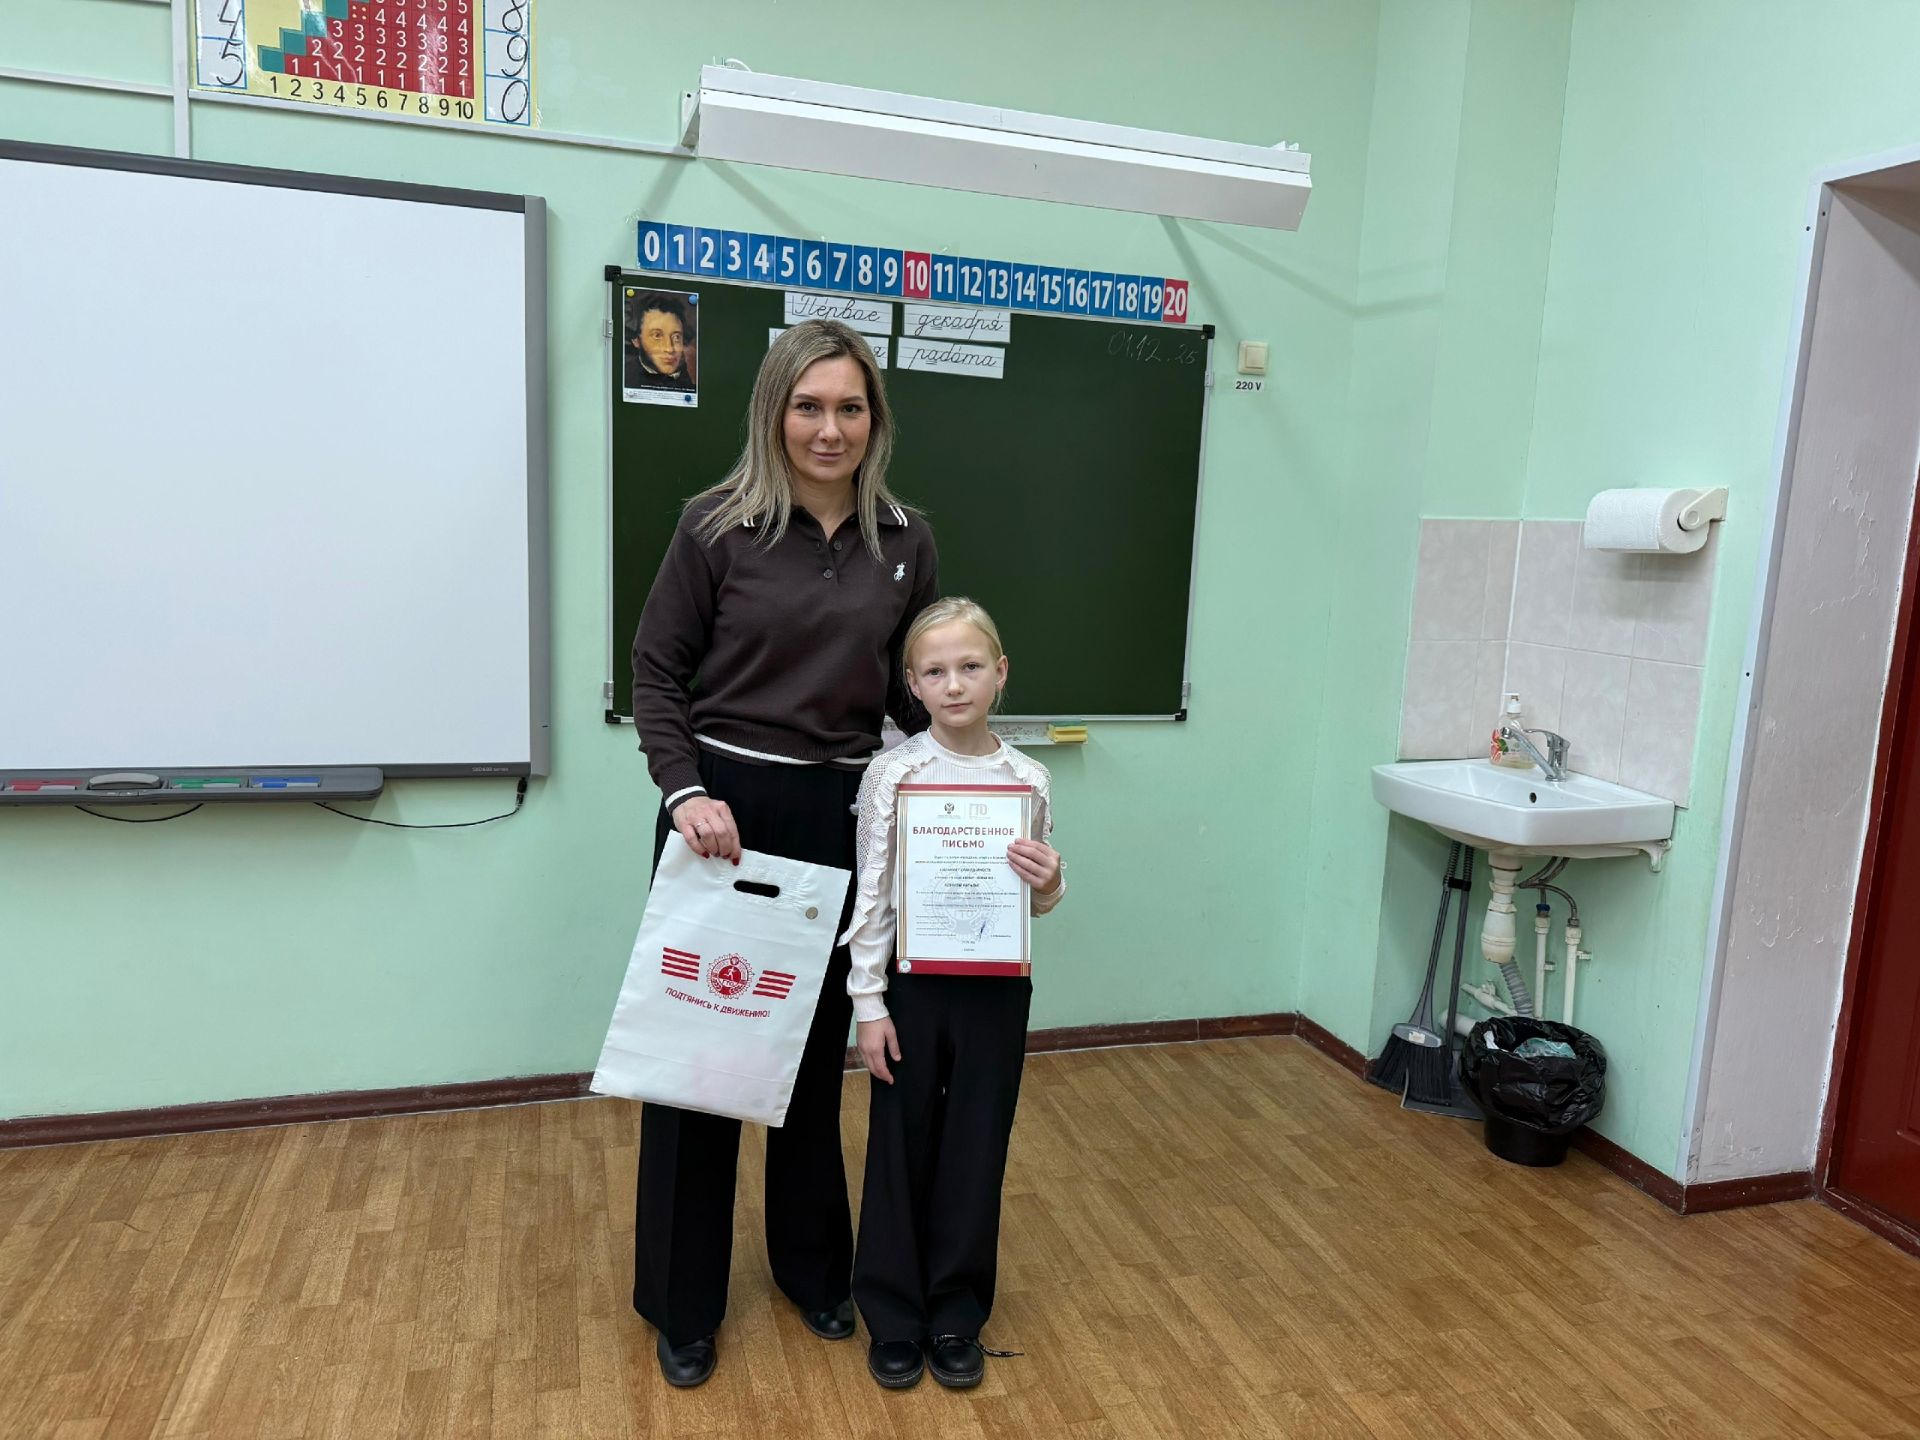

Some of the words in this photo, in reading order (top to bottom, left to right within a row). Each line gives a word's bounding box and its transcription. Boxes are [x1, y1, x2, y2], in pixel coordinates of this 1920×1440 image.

[219, 0, 242, 39] 4
[375, 8, 386, 25] 4
[396, 11, 407, 28] 4
[417, 14, 427, 30] 4
[437, 16, 448, 32] 4
[457, 19, 468, 35] 4
[458, 0, 467, 14] 5
[502, 0, 527, 32] 8
[333, 20, 343, 37] 3
[354, 24, 365, 41] 3
[376, 27, 386, 44] 3
[397, 31, 406, 48] 3
[418, 33, 427, 50] 3
[438, 35, 448, 52] 3
[458, 37, 468, 55] 3
[216, 40, 243, 85] 5
[312, 39, 322, 56] 2
[333, 42, 344, 59] 2
[354, 45, 365, 62] 2
[376, 48, 386, 65] 2
[397, 52, 407, 68] 2
[418, 54, 427, 71] 2
[438, 57, 448, 74] 2
[458, 59, 468, 76] 2
[501, 35, 528, 77] 9
[291, 58, 298, 74] 1
[313, 61, 320, 77] 1
[335, 63, 342, 80] 1
[356, 66, 362, 82] 1
[378, 70, 384, 85] 1
[398, 73, 404, 89] 1
[419, 76, 426, 92] 1
[439, 78, 445, 94] 1
[459, 80, 465, 96] 1
[270, 76, 277, 93] 1
[290, 79, 302, 97] 2
[313, 82, 323, 100] 3
[334, 85, 345, 102] 4
[356, 87, 367, 106] 5
[377, 90, 388, 108] 6
[399, 93, 407, 111] 7
[419, 97, 429, 114] 8
[439, 99, 449, 116] 9
[455, 101, 473, 119] 10
[501, 80, 528, 122] 0
[644, 230, 660, 262] 0
[673, 234, 685, 264] 1
[700, 237, 714, 268] 2
[727, 239, 742, 271] 3
[753, 244, 769, 274] 4
[780, 246, 794, 278] 5
[806, 249, 820, 280] 6
[832, 252, 847, 282] 7
[858, 254, 873, 285] 8
[883, 256, 898, 288] 9
[906, 258, 928, 291] 10
[933, 262, 954, 294] 11
[961, 266, 982, 297] 12
[987, 268, 1009, 300] 13
[1014, 271, 1036, 302] 14
[1040, 274, 1062, 305] 15
[1066, 277, 1088, 307] 16
[1091, 280, 1113, 309] 17
[1117, 282, 1138, 312] 18
[1142, 284, 1163, 314] 19
[1164, 287, 1186, 317] 20
[793, 296, 881, 323] Первое
[908, 344, 998, 370] работа
[1236, 381, 1253, 391] 220
[1254, 382, 1262, 391] V
[913, 827, 1015, 836] БЛАГОДАРСТВЕННОЕ
[942, 840, 985, 848] ПИСЬМО
[665, 987, 712, 1009] ПОДТЯНИСЬ
[713, 1003, 719, 1012] К
[720, 1005, 770, 1018] ДВИЖЕНИЮ!
